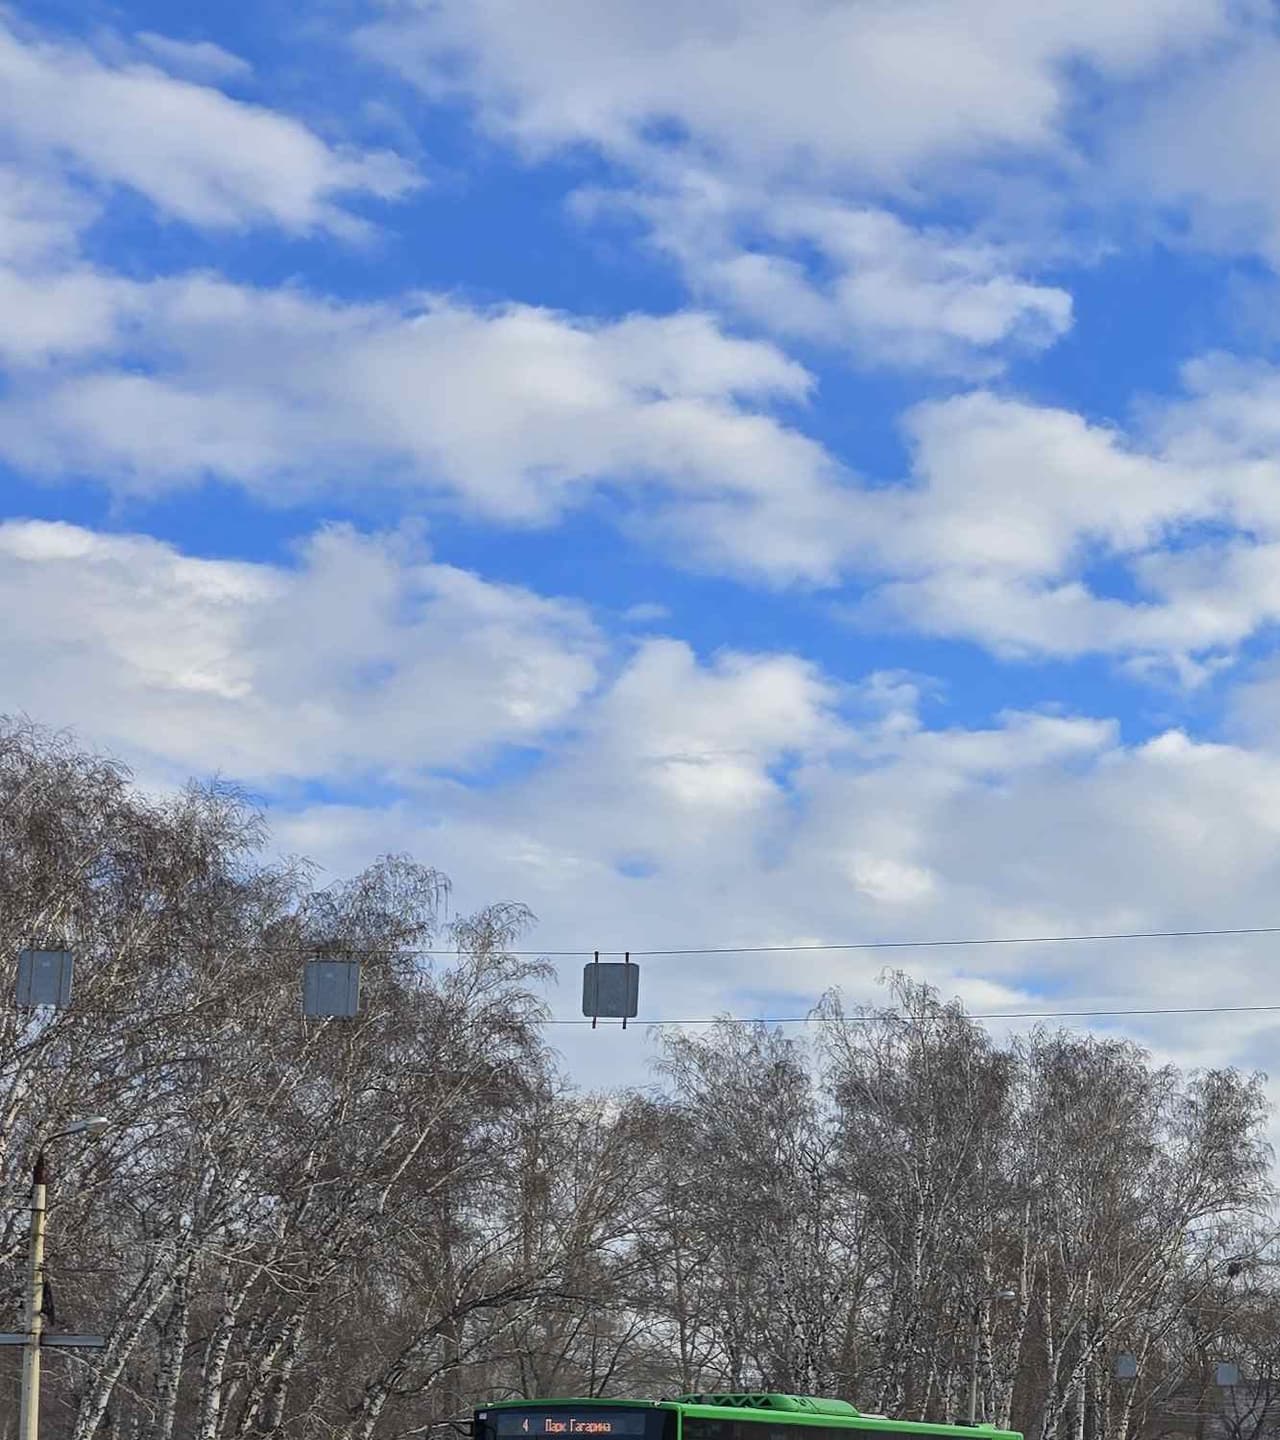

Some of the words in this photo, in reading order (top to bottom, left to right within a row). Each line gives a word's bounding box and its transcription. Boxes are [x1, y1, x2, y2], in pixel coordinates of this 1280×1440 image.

[522, 1418, 529, 1432] 4
[545, 1419, 567, 1432] Парк
[570, 1419, 612, 1432] Гагарина
